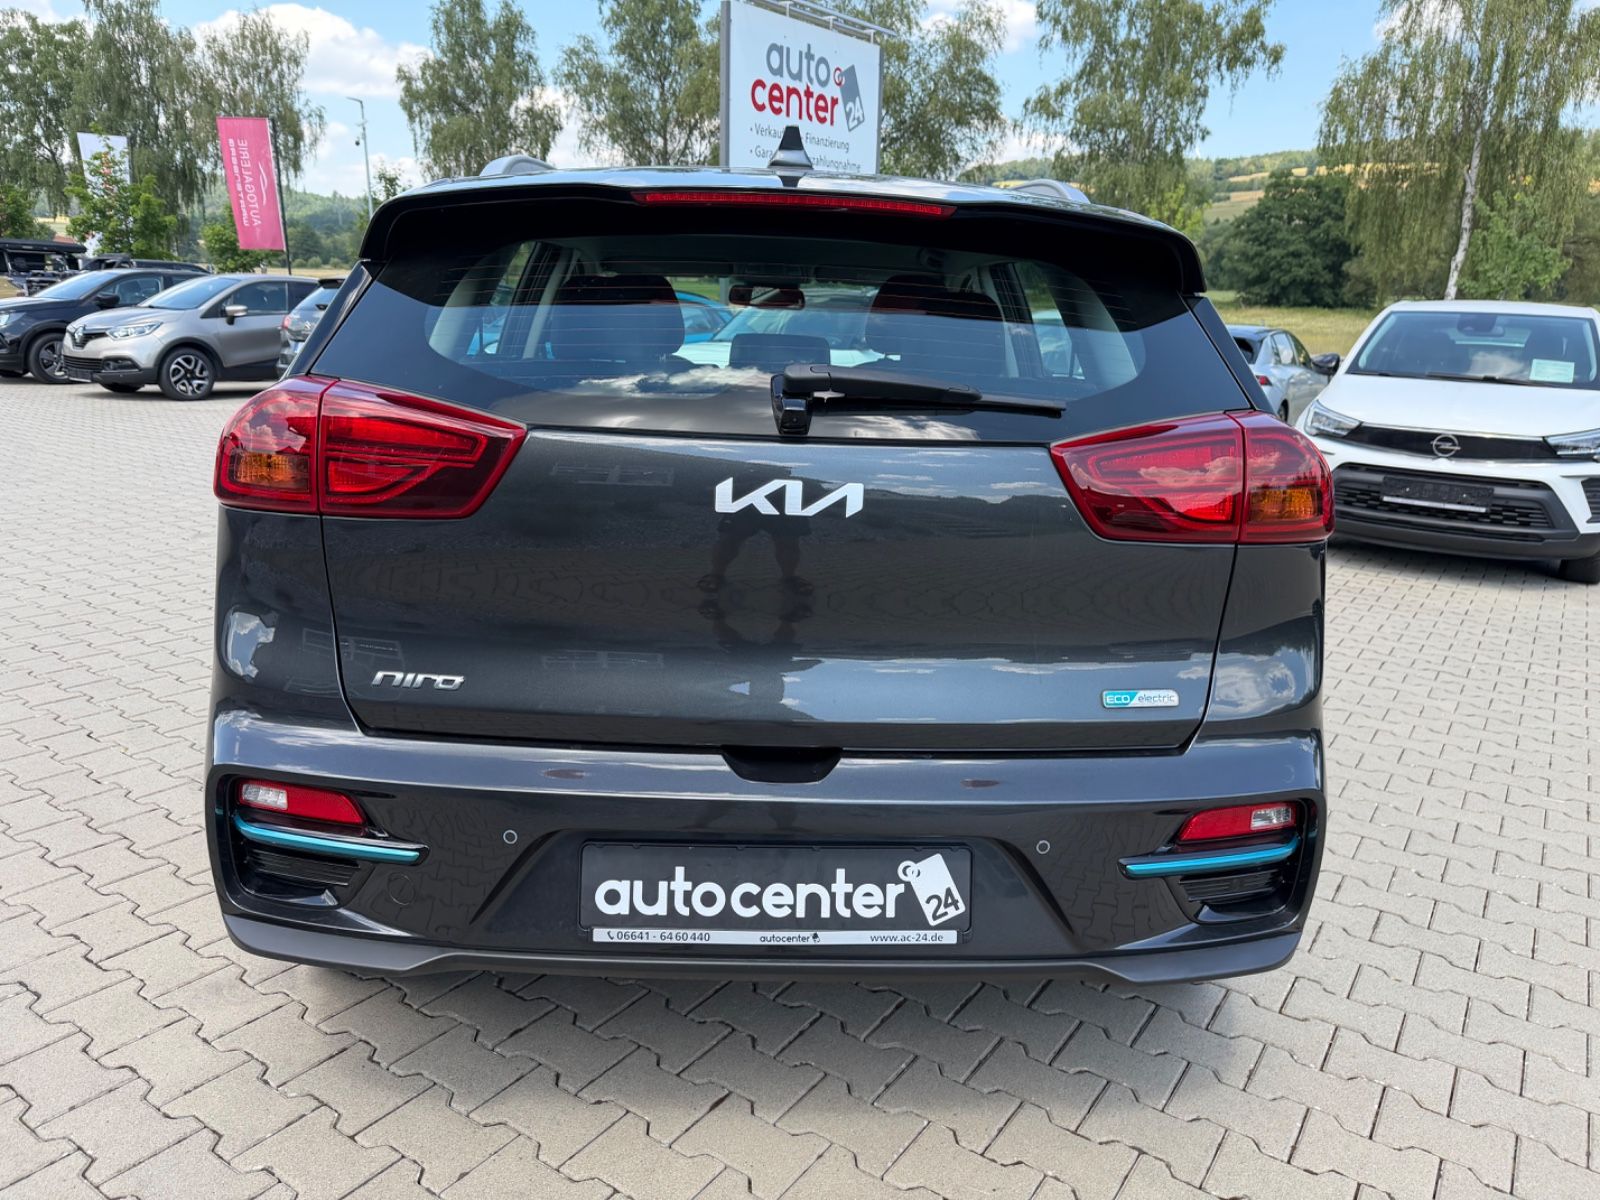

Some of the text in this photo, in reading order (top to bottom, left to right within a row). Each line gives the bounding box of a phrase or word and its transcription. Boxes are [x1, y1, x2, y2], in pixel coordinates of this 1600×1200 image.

[766, 43, 831, 88] auto
[751, 79, 839, 126] center
[845, 96, 864, 127] 24
[754, 123, 849, 153] Verkau Finanzierung
[715, 477, 864, 518] KIA
[1138, 693, 1175, 703] electric
[925, 887, 960, 921] 24
[616, 930, 650, 941] 06641
[759, 933, 810, 943] autocenter
[870, 933, 944, 943] www.ac-24.de
